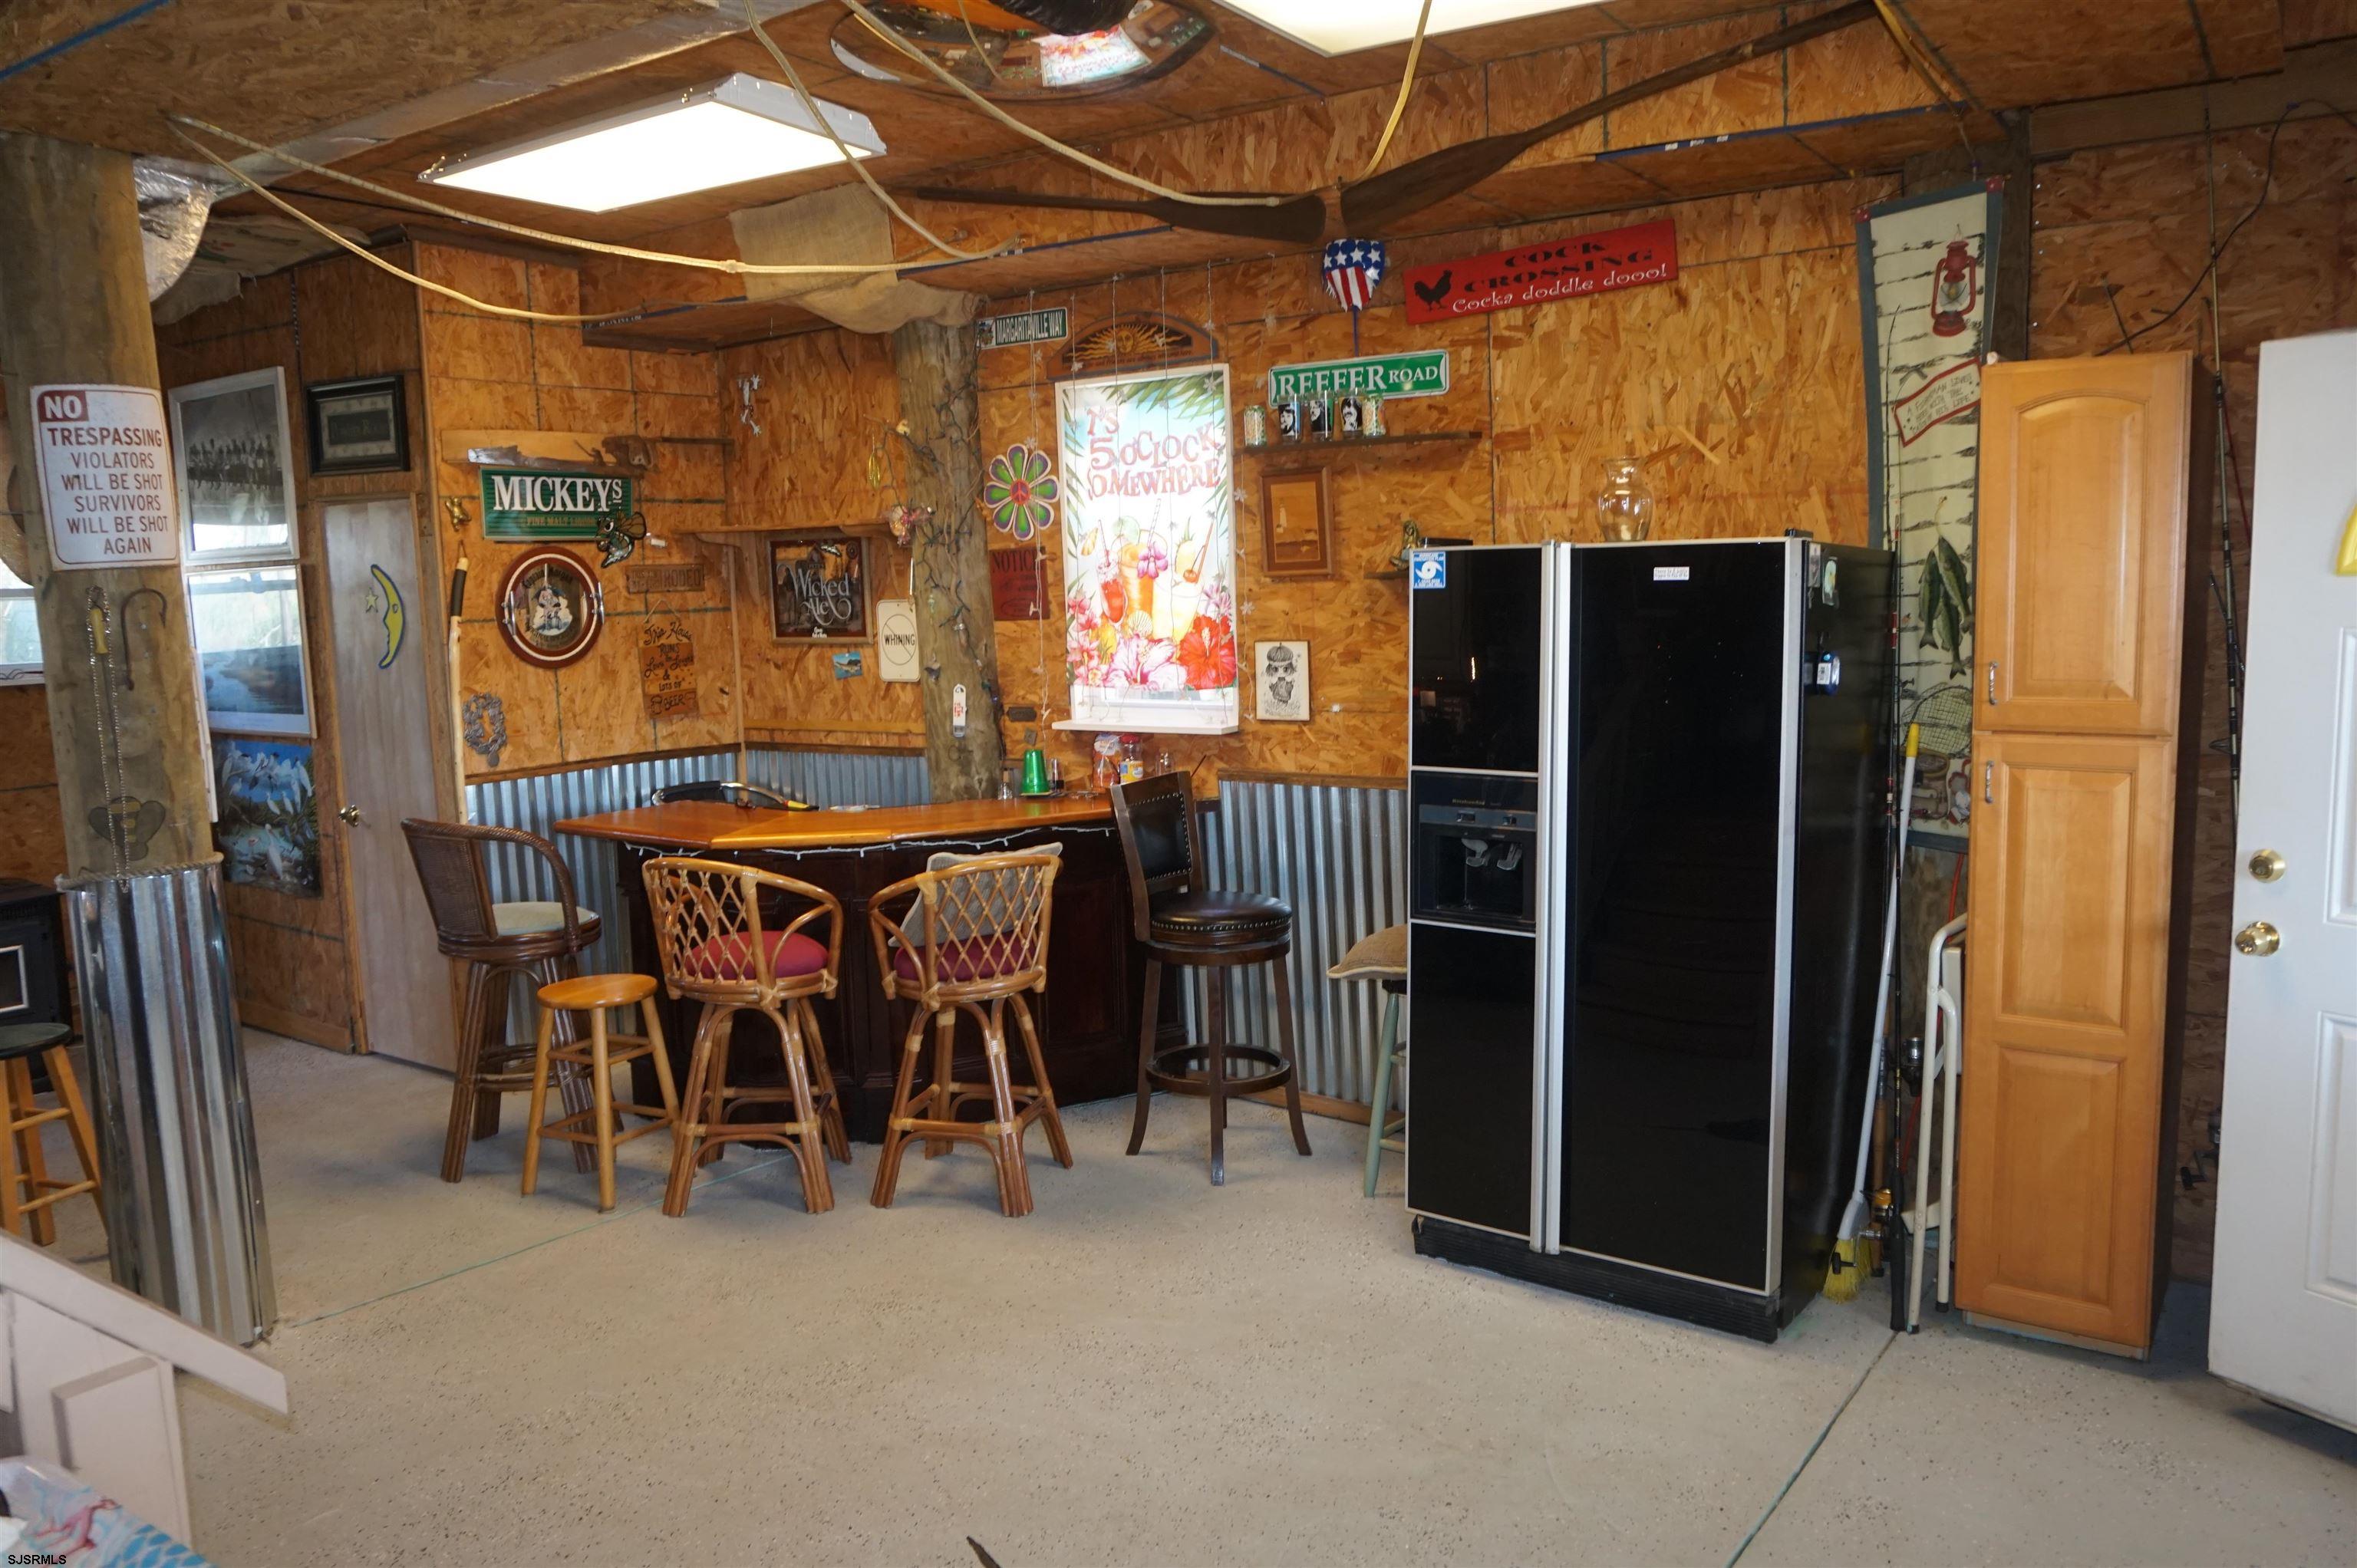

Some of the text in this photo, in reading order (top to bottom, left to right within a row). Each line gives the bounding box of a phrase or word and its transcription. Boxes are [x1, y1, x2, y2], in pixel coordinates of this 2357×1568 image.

[1504, 242, 1607, 268] COCK
[1463, 249, 1653, 292] CROSSING
[1452, 262, 1667, 313] Cocka doddle dooo!
[997, 311, 1063, 344] MARGARITAVILLE WAY
[1277, 364, 1439, 397] REEFER ROAD
[43, 394, 82, 419] NO
[47, 427, 163, 447] TRESPASSING
[1089, 421, 1221, 470] 5 O'CLOCK
[71, 452, 154, 469] VIOLATORS
[61, 473, 163, 491] WILL BE SHOT
[1086, 457, 1221, 501] SOMEWHERE
[74, 494, 161, 512] SURVIVORS
[66, 516, 168, 535] WILL BE SHOT
[548, 516, 568, 526] MALT
[569, 516, 598, 527] LIQUO
[104, 536, 152, 555] AGAIN
[662, 568, 702, 588] RODEO
[776, 563, 852, 619] Wicked
[800, 598, 835, 625] Ale
[644, 623, 667, 646] This
[884, 634, 915, 647] WHINING
[662, 668, 671, 681] &
[663, 693, 686, 711] BEER
